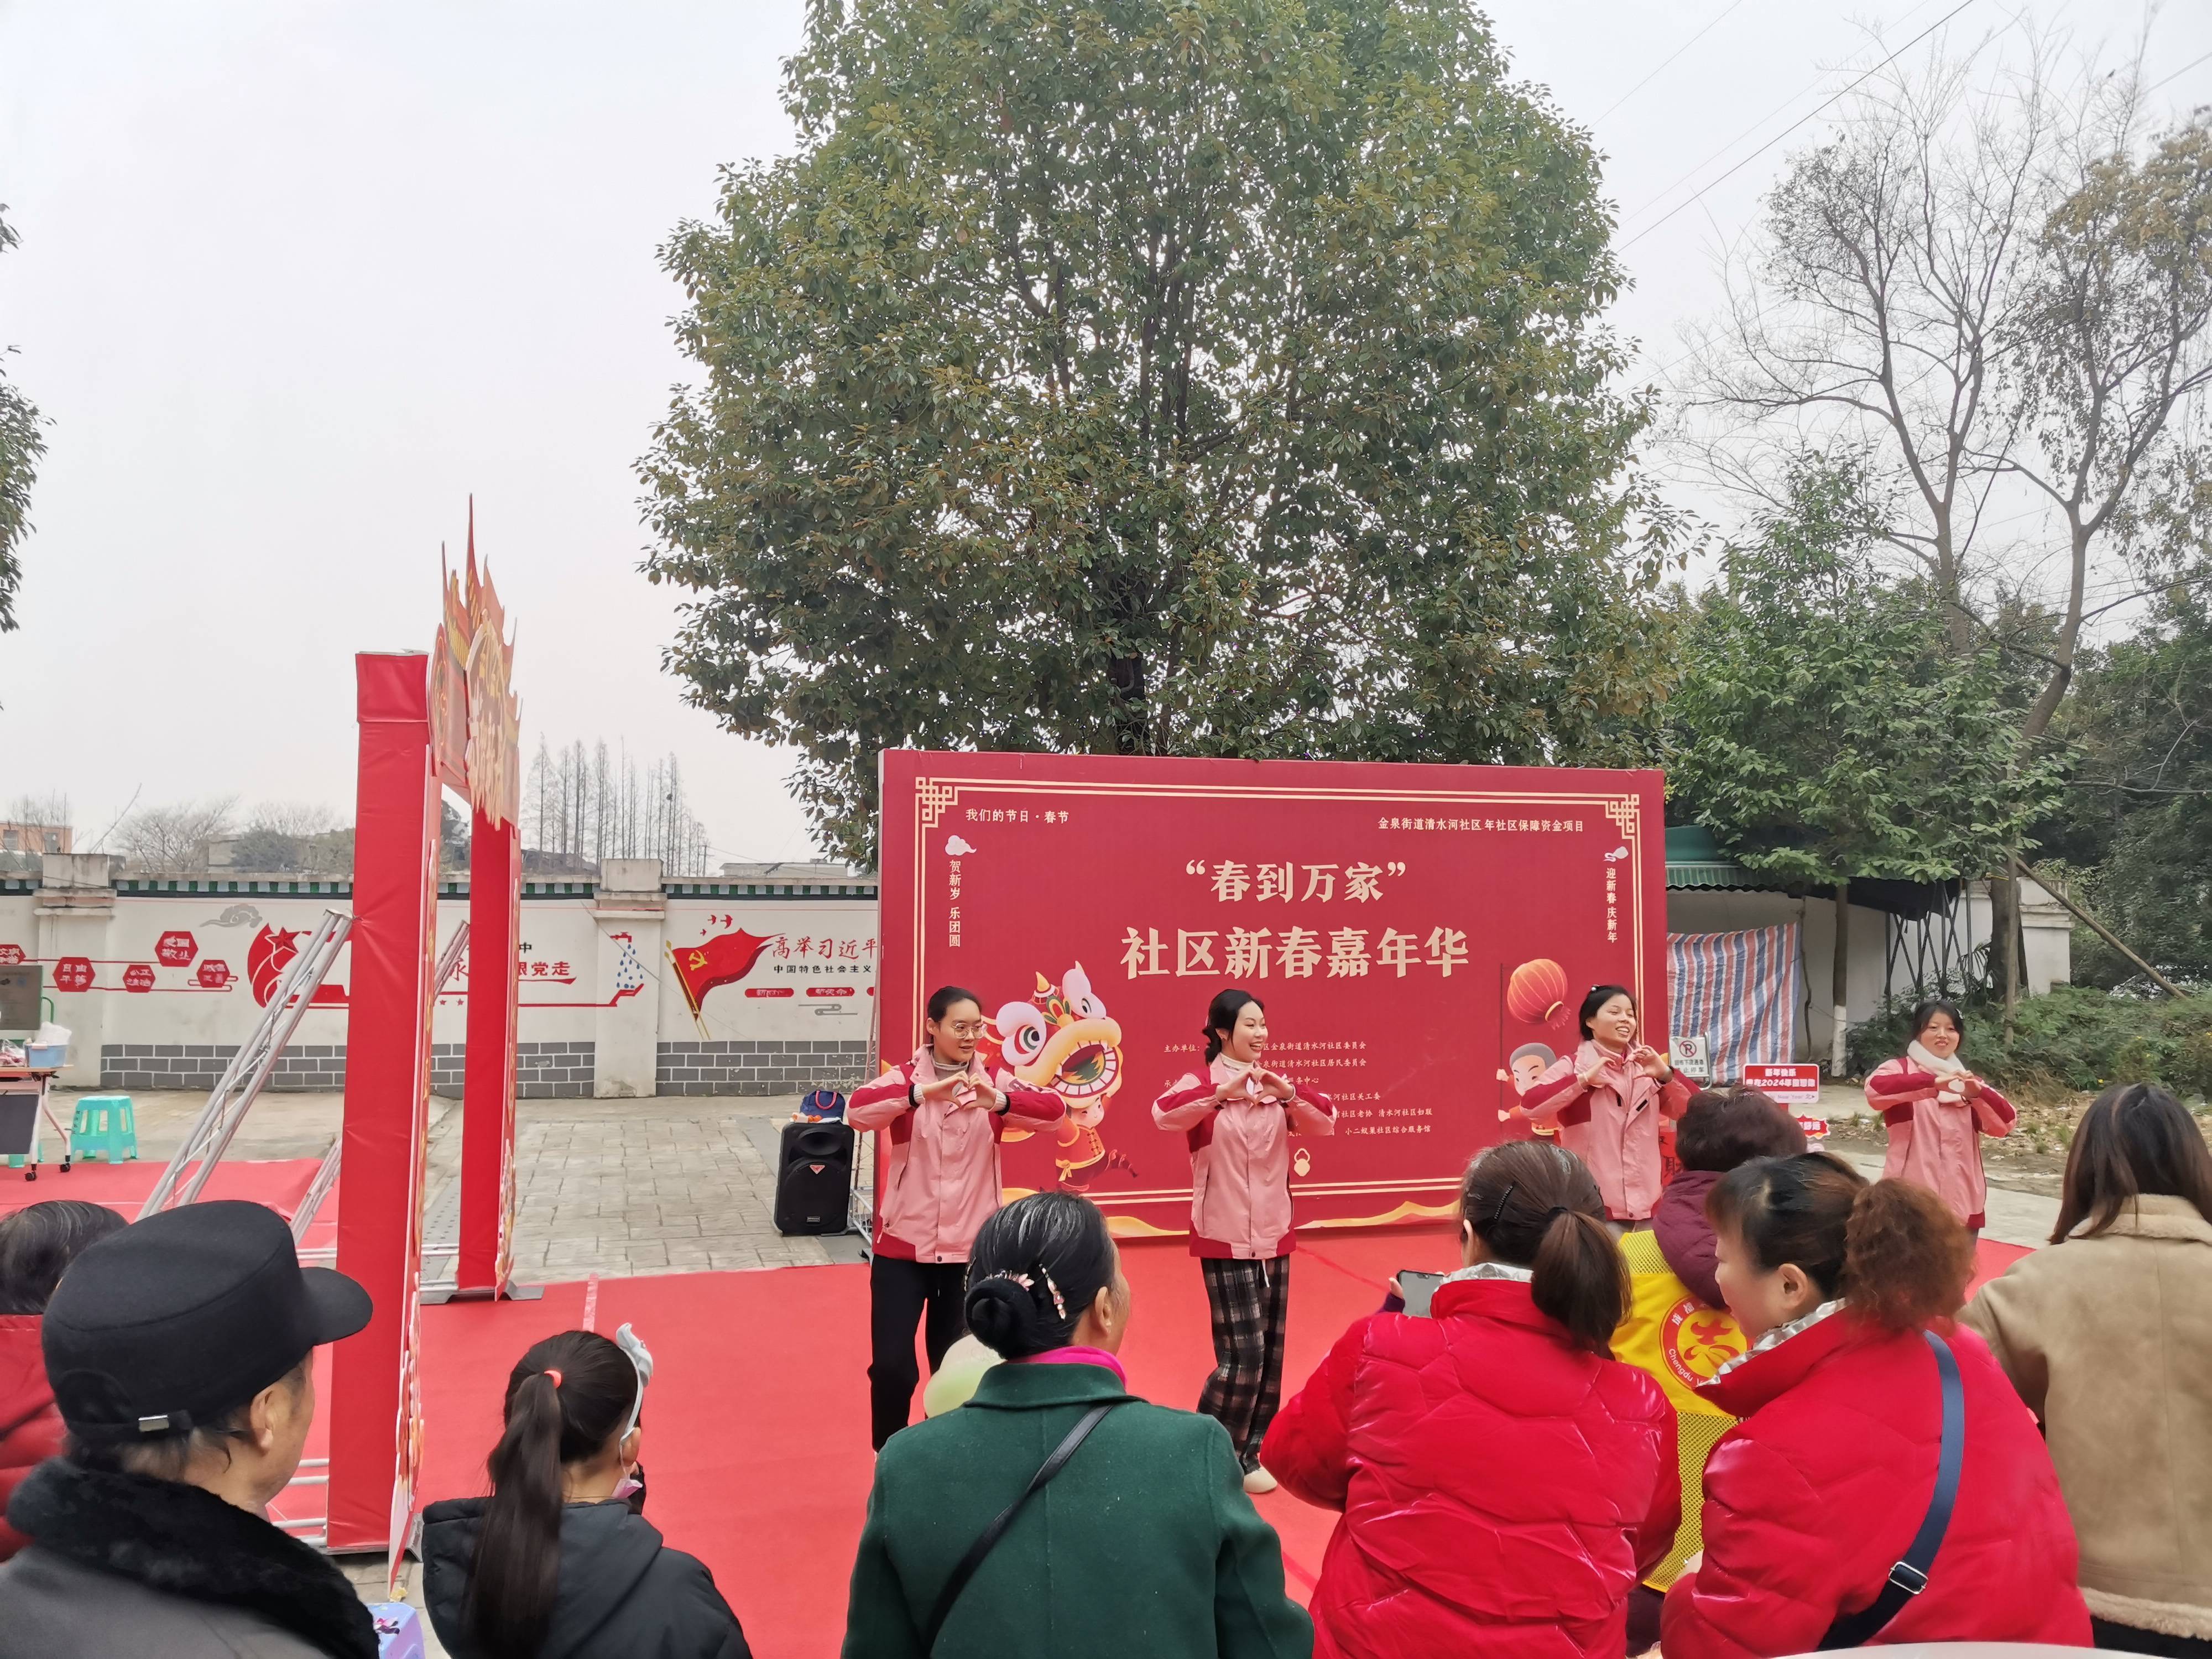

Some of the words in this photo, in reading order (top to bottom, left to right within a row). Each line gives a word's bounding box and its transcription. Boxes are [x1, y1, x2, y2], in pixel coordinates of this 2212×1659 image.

[519, 942, 531, 953] 中
[773, 936, 878, 959] 高举习近平
[1120, 926, 1469, 979] 社区新春嘉年华
[774, 964, 871, 973] 中国特色社会主义
[1668, 1348, 1693, 1382] Chengdu
